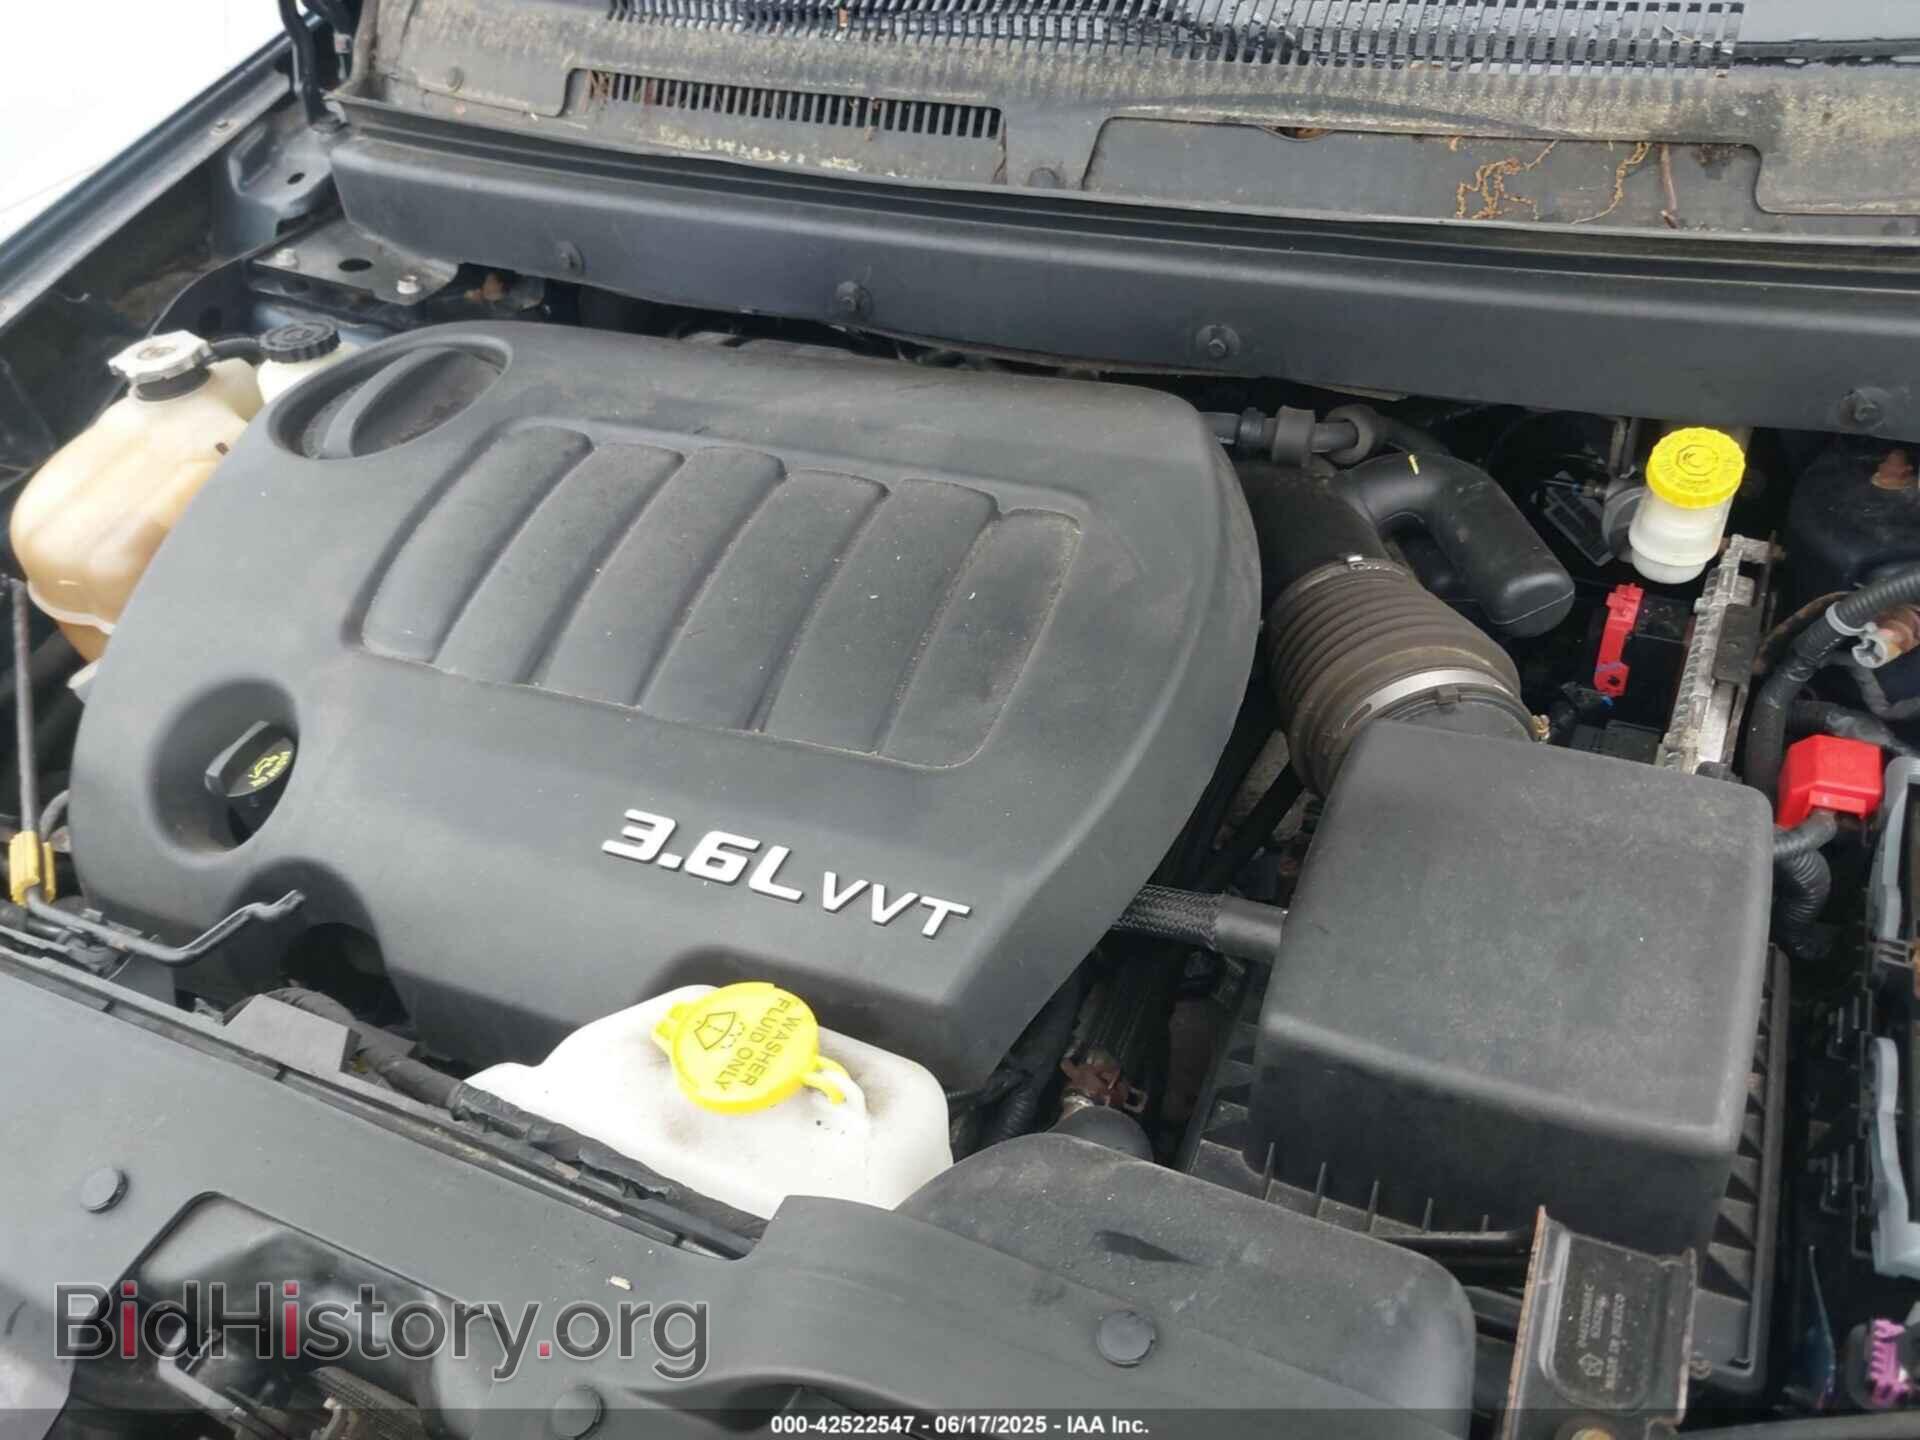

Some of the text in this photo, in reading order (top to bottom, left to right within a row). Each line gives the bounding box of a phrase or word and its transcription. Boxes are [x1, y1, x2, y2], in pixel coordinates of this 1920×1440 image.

[602, 808, 971, 938] 3.6L VVT
[715, 998, 791, 1091] FLUID ONLY
[742, 1016, 801, 1086] WASHER
